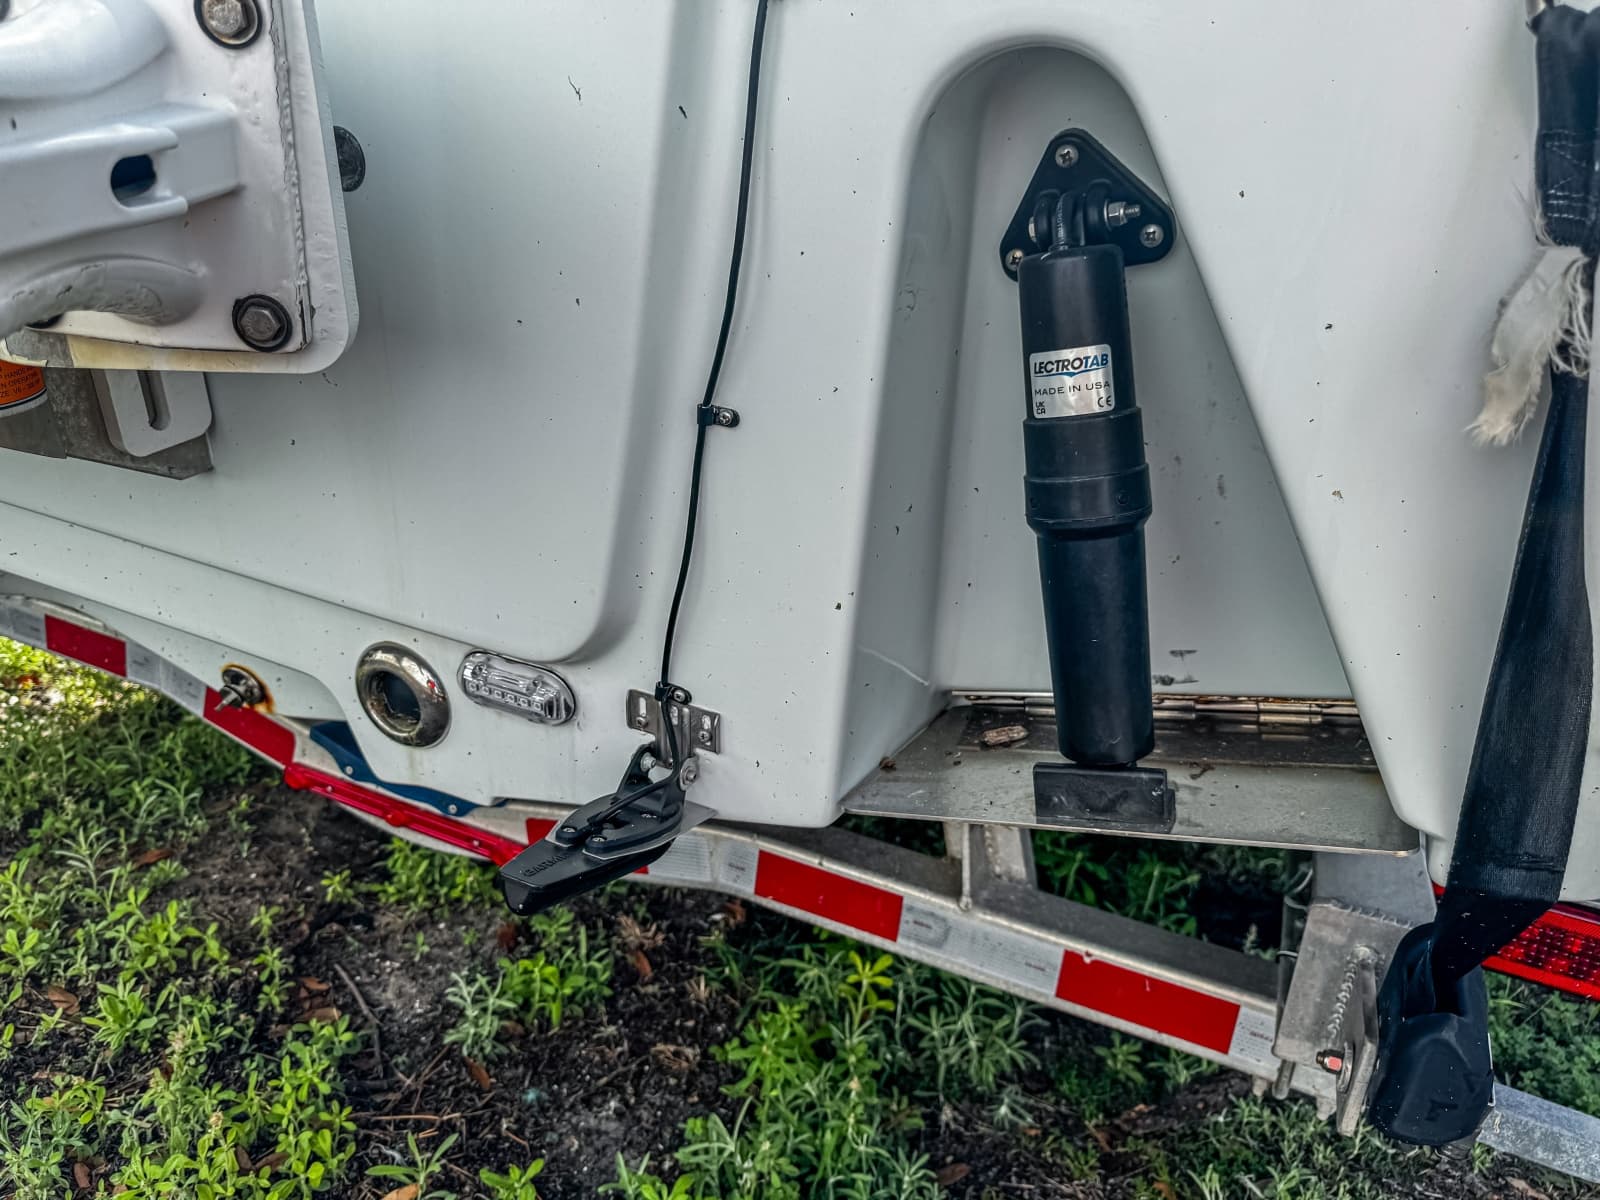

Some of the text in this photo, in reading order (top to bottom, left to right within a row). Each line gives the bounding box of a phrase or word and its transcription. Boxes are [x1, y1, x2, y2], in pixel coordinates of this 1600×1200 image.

[1034, 354, 1109, 374] LECTROTAB
[1035, 381, 1110, 396] MADE IN USA
[1097, 395, 1112, 408] CE
